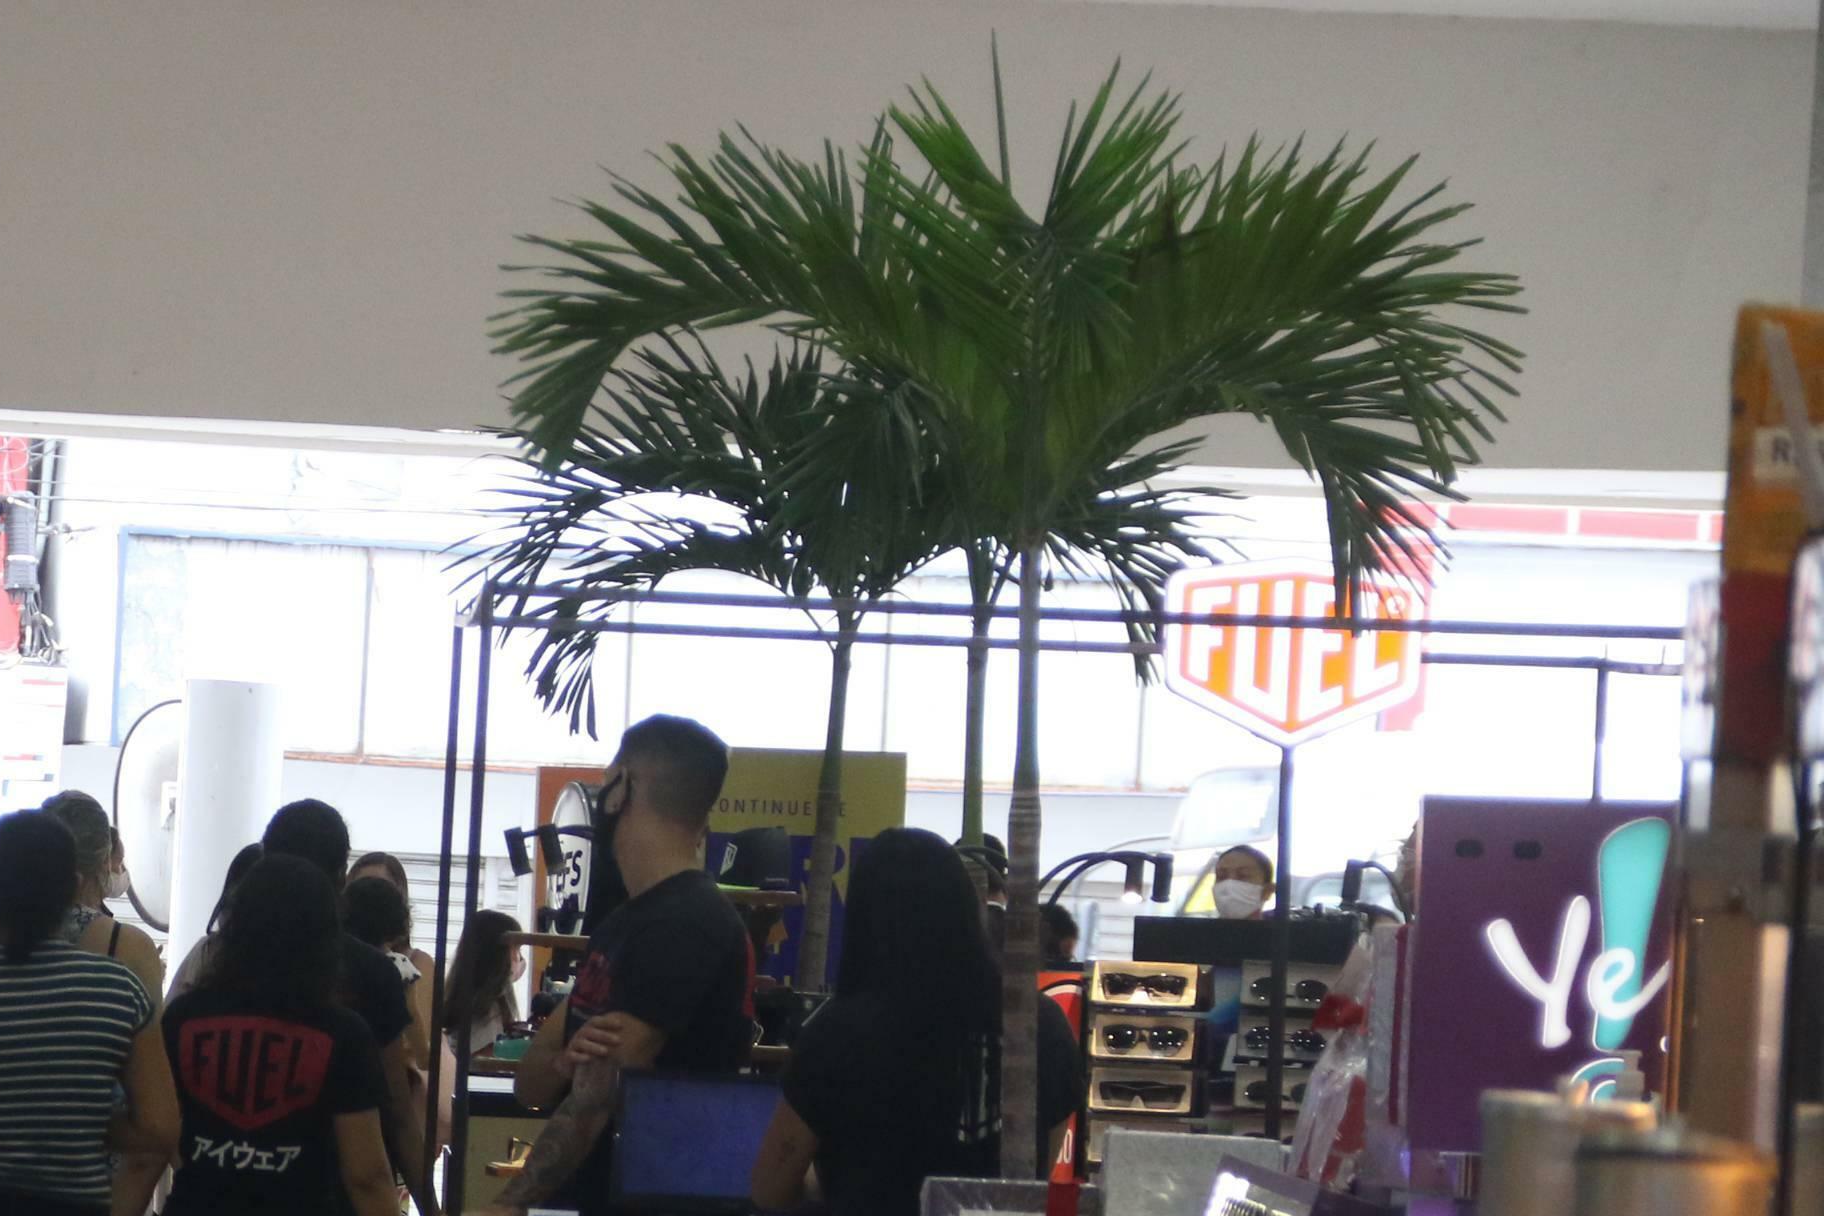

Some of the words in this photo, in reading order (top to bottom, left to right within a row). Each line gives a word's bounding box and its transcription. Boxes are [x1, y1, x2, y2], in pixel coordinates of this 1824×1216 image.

[1188, 578, 1400, 724] FUEL
[711, 798, 813, 817] ONTINUE
[191, 1028, 306, 1115] FUEL
[192, 1135, 302, 1173] アイウェア
